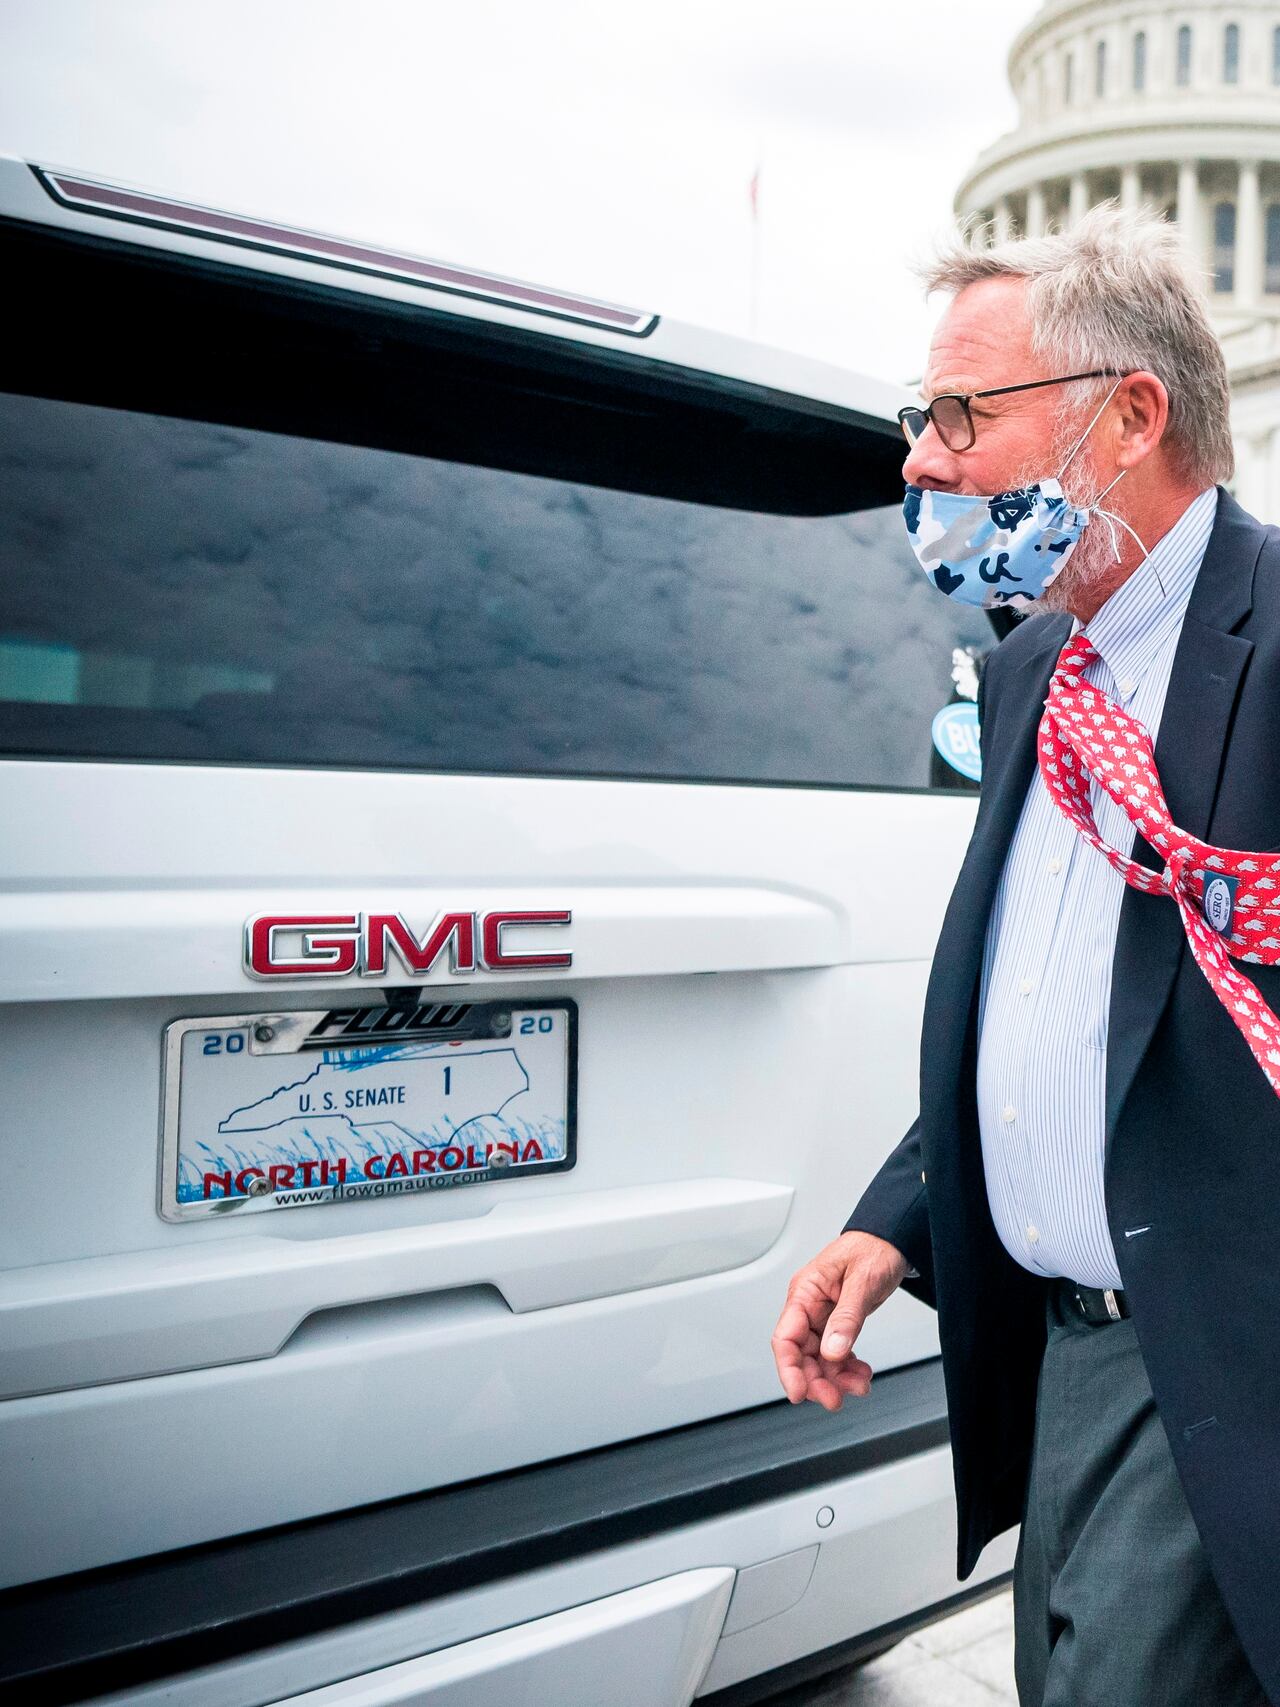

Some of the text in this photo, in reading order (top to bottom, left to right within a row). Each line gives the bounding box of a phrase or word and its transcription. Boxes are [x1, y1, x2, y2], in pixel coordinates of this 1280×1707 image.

[1213, 892, 1223, 919] SERO
[243, 908, 574, 982] GMC
[309, 1004, 473, 1036] FLOW
[520, 1017, 553, 1035] 20
[202, 1033, 245, 1056] 20
[442, 1066, 452, 1096] 1
[298, 1086, 406, 1112] U. S. SENATE
[203, 1139, 544, 1199] NORTH CAROLINA
[275, 1171, 489, 1206] www.flowgmauto.com
